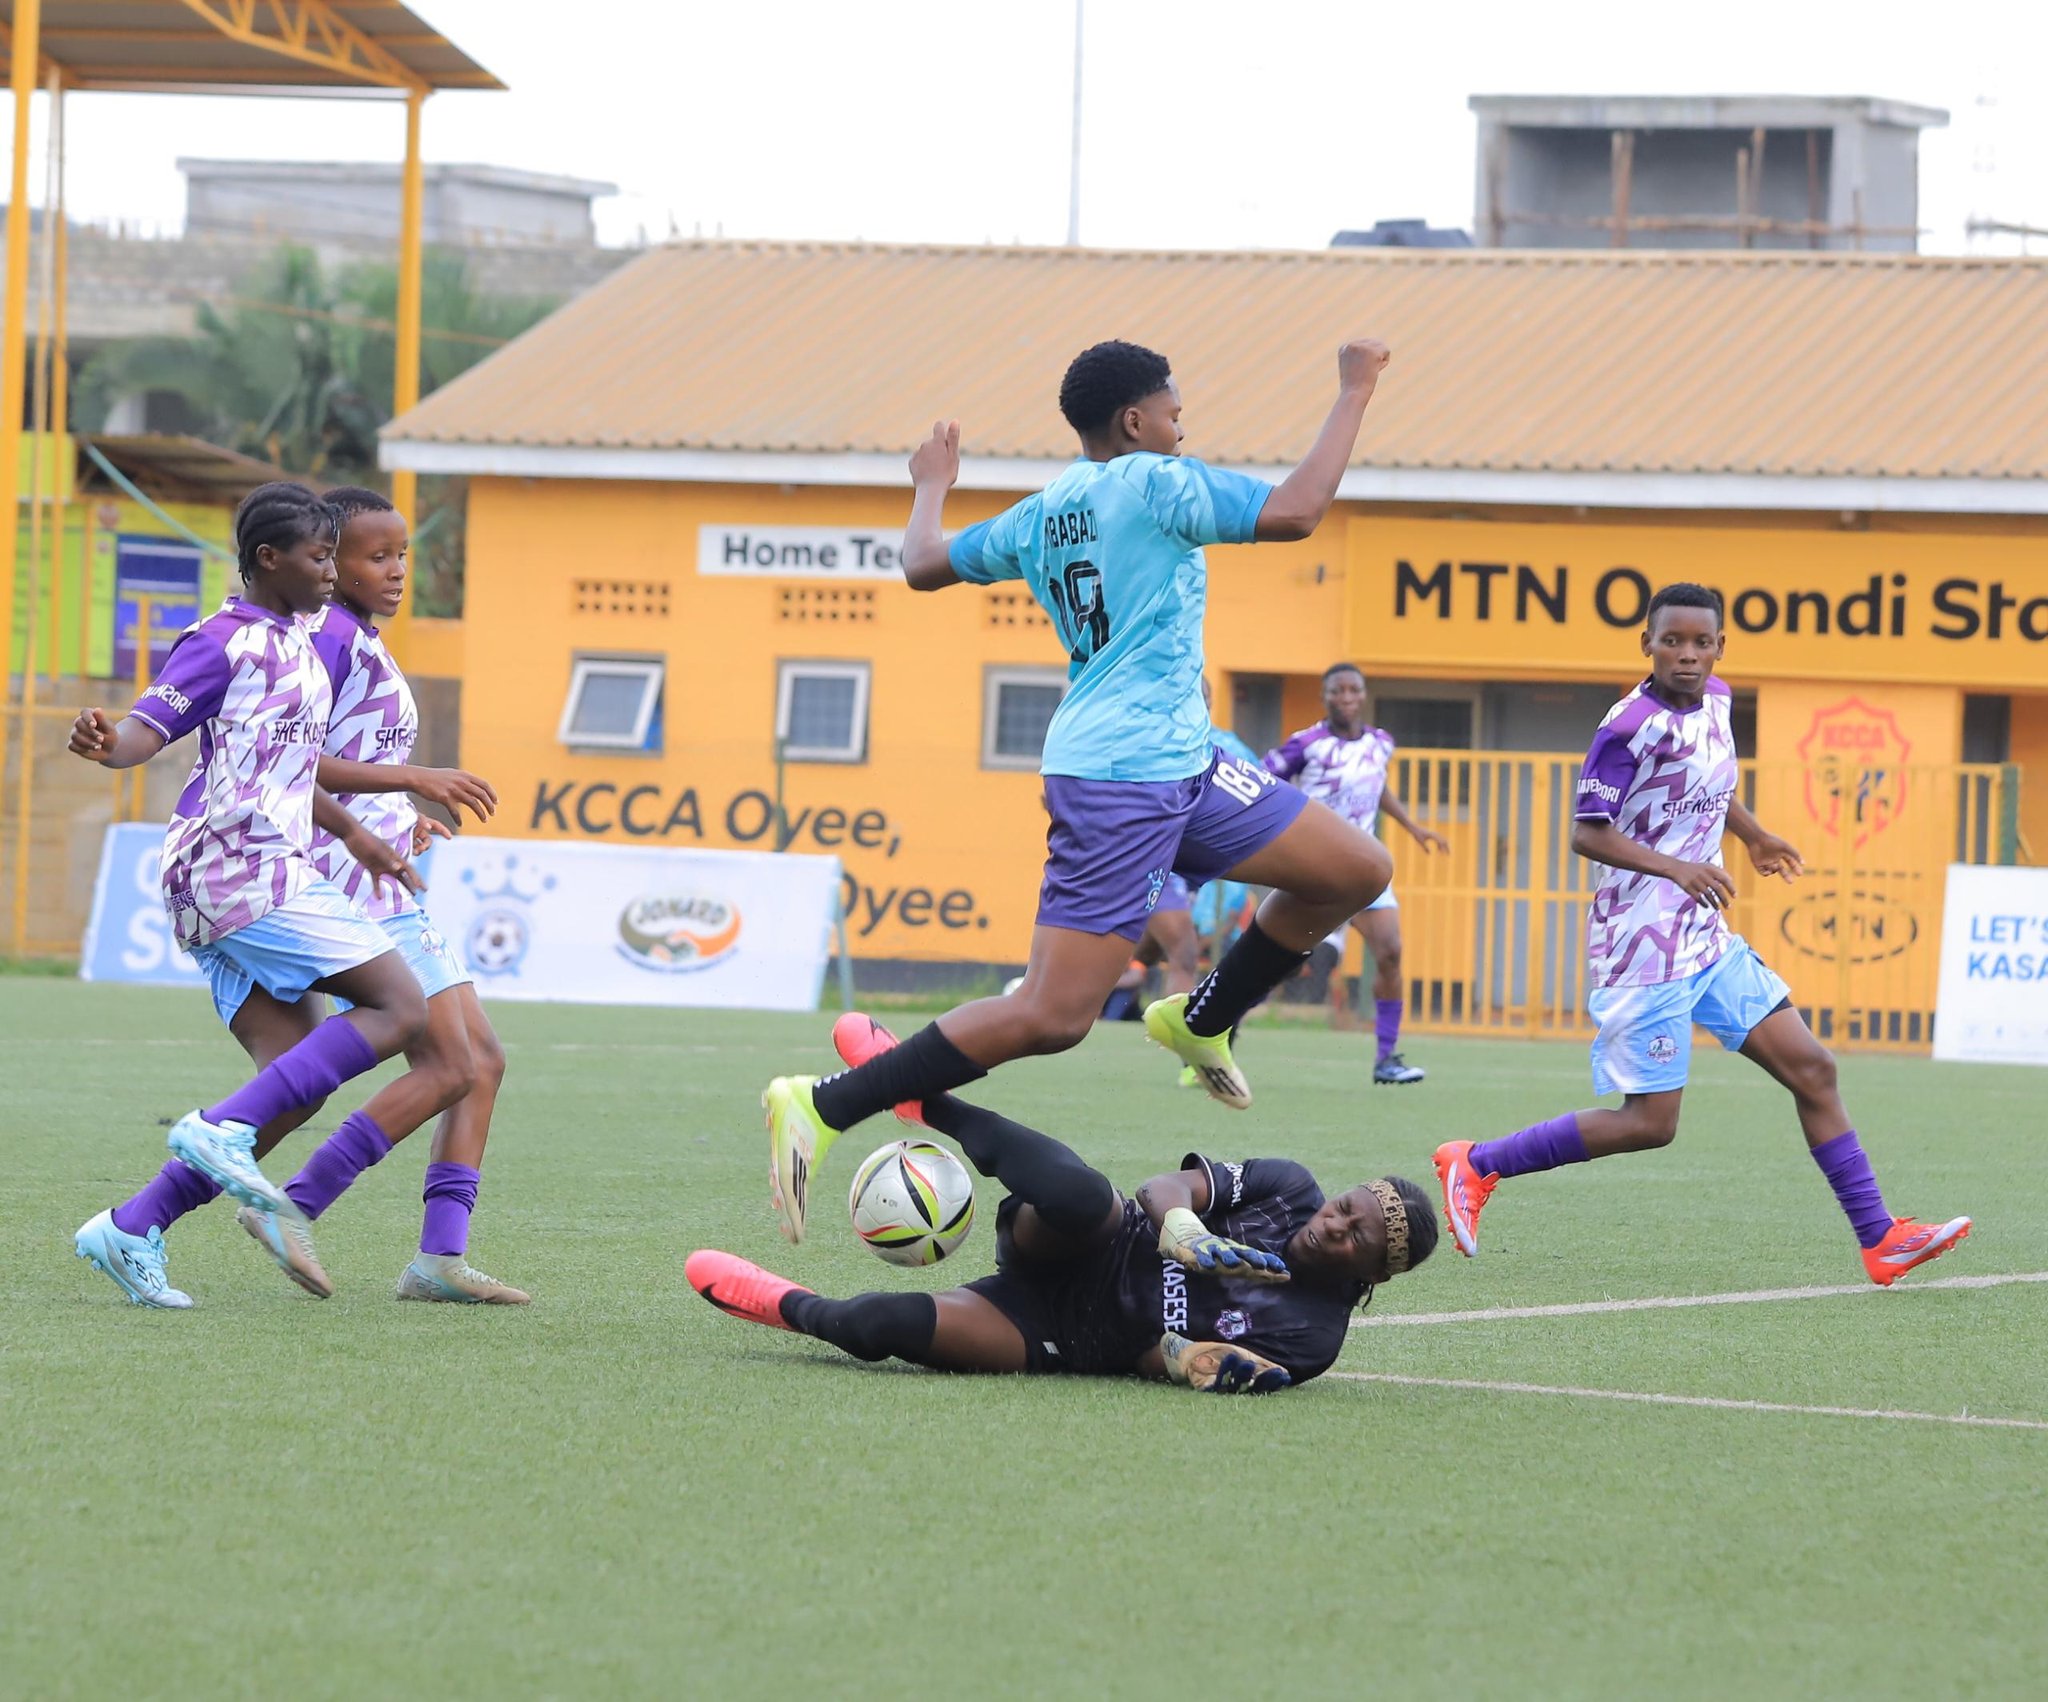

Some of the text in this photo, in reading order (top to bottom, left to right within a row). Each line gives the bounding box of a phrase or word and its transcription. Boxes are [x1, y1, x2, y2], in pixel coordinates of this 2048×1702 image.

[723, 533, 904, 570] Home Te
[1394, 561, 1568, 623] MTN
[1594, 567, 1905, 639] Oondi
[530, 781, 902, 858] KCCA Oyee,
[1211, 761, 1261, 807] 18
[1163, 1259, 1188, 1333] KASESE
